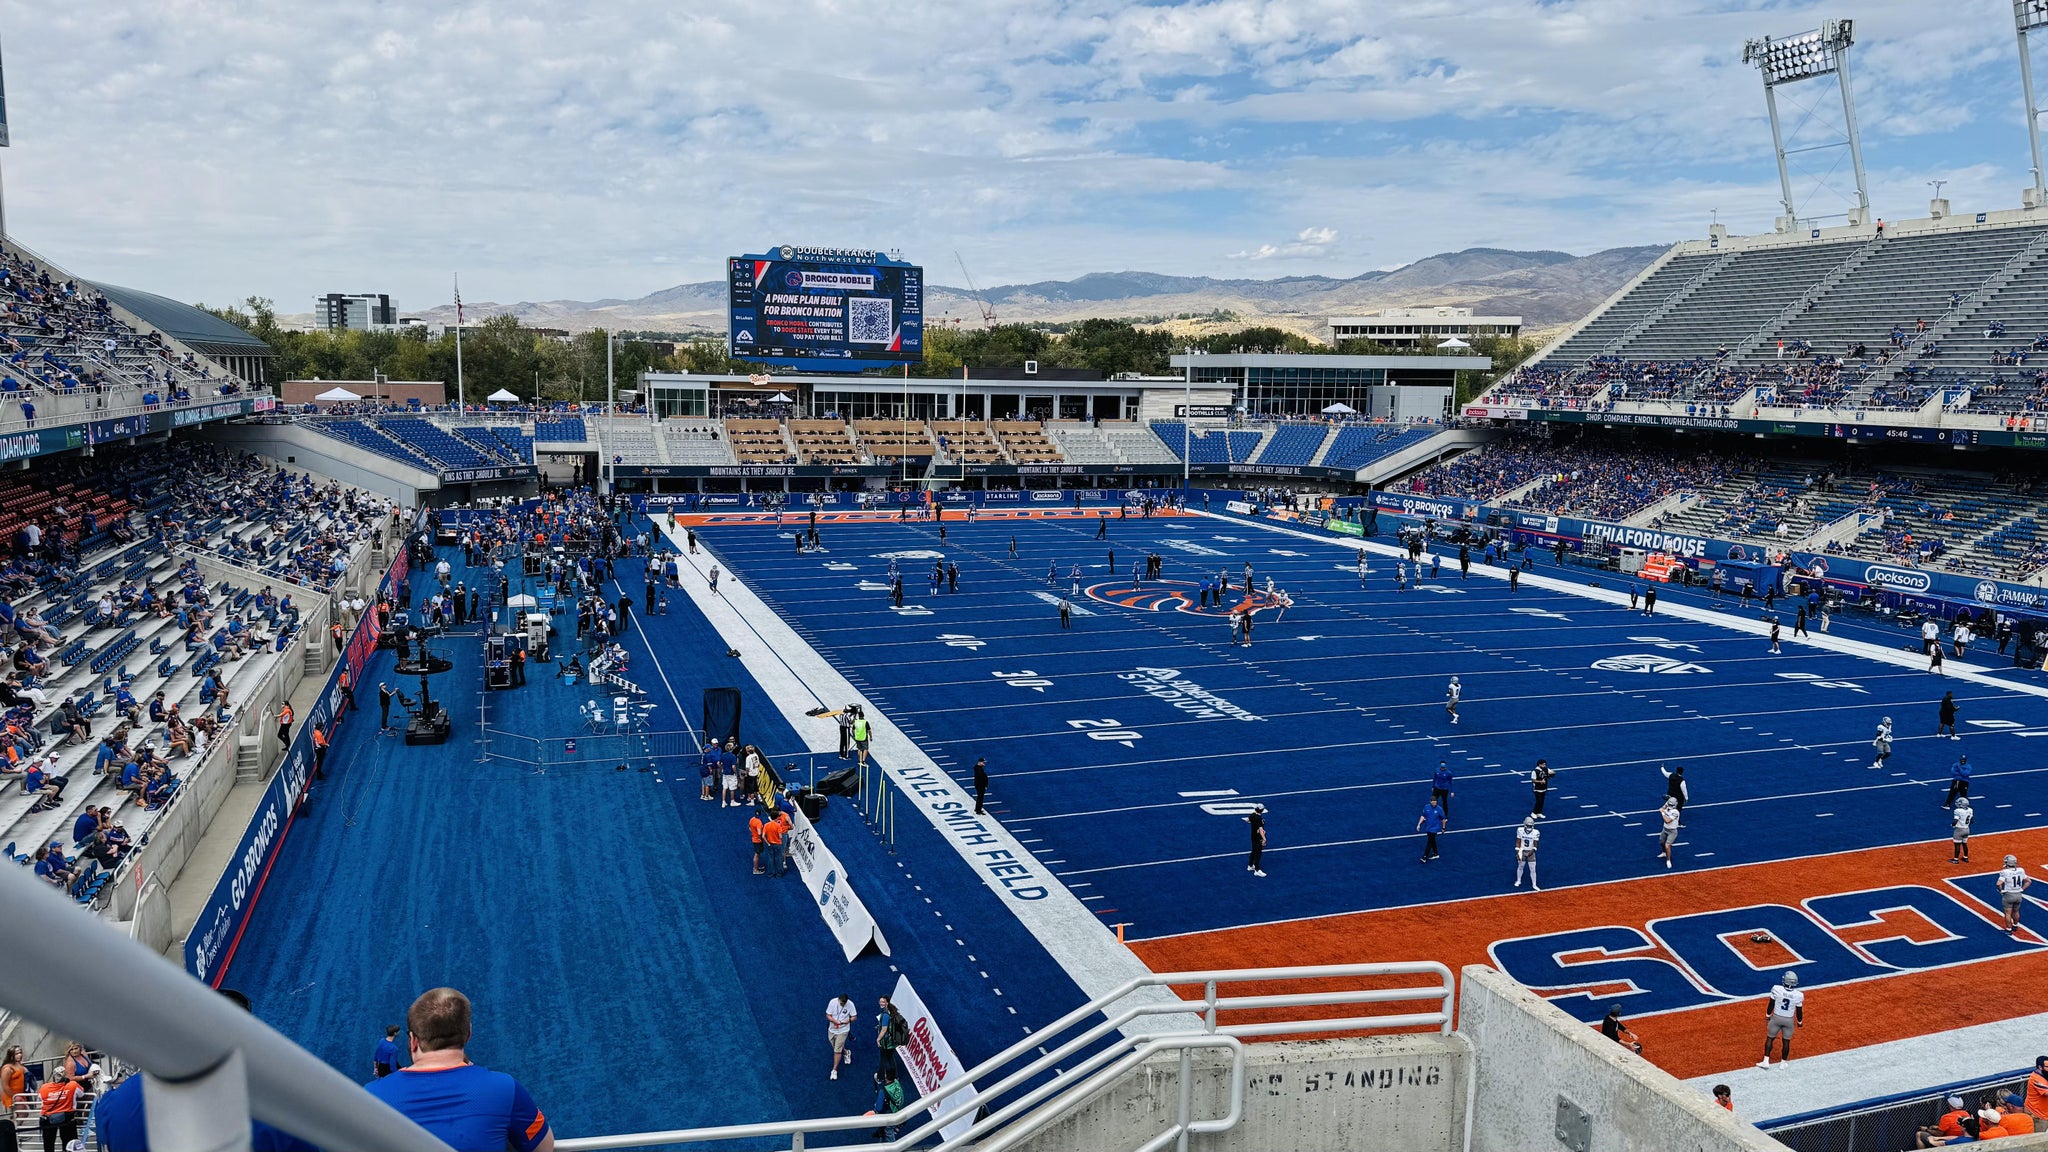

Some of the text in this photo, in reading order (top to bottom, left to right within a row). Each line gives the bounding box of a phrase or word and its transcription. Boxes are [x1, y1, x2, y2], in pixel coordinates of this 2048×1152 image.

[797, 246, 876, 257] DOUBLE R RANCH
[797, 255, 851, 263] Northwest
[805, 274, 838, 283] BRONCO
[840, 276, 871, 285] MOBILE
[765, 294, 843, 306] A PHONE PLAN BUILT
[764, 306, 843, 318] FOR BRONCO NATION
[1585, 412, 1738, 429] SHOP. COMPARE. ENROLL. YOURHEALTHIDAHO.ORG
[1852, 428, 1858, 436] 0
[1886, 429, 1908, 438] 45:46
[1938, 432, 1945, 440] 0
[456, 472, 463, 481] AS
[463, 471, 475, 481] THEY
[475, 469, 494, 480] SHOULD
[710, 467, 796, 476] MOUNTAINS AS THEY SHOULD BE.
[1017, 466, 1042, 474] MOUNTAINS
[1049, 466, 1060, 474] THEY
[1077, 466, 1085, 474] BE.
[1229, 465, 1255, 473] MOUNTAINS
[1402, 499, 1453, 515] GO BRONCOS
[1873, 569, 1925, 588] Jacksons
[936, 633, 987, 646] 40
[991, 670, 1055, 688] 30
[1117, 673, 1226, 719] STADIUM
[1167, 679, 1262, 722] Albertsons
[1066, 718, 1144, 741] 20
[1177, 788, 1269, 816] 10
[897, 767, 1050, 901] LYLE SMITH FIELD
[1524, 839, 1530, 847] 9
[231, 802, 278, 911] GO BRONCOS
[2011, 876, 2021, 888] 14
[1781, 998, 1791, 1011] 3
[1304, 1066, 1440, 1093] STANDING
